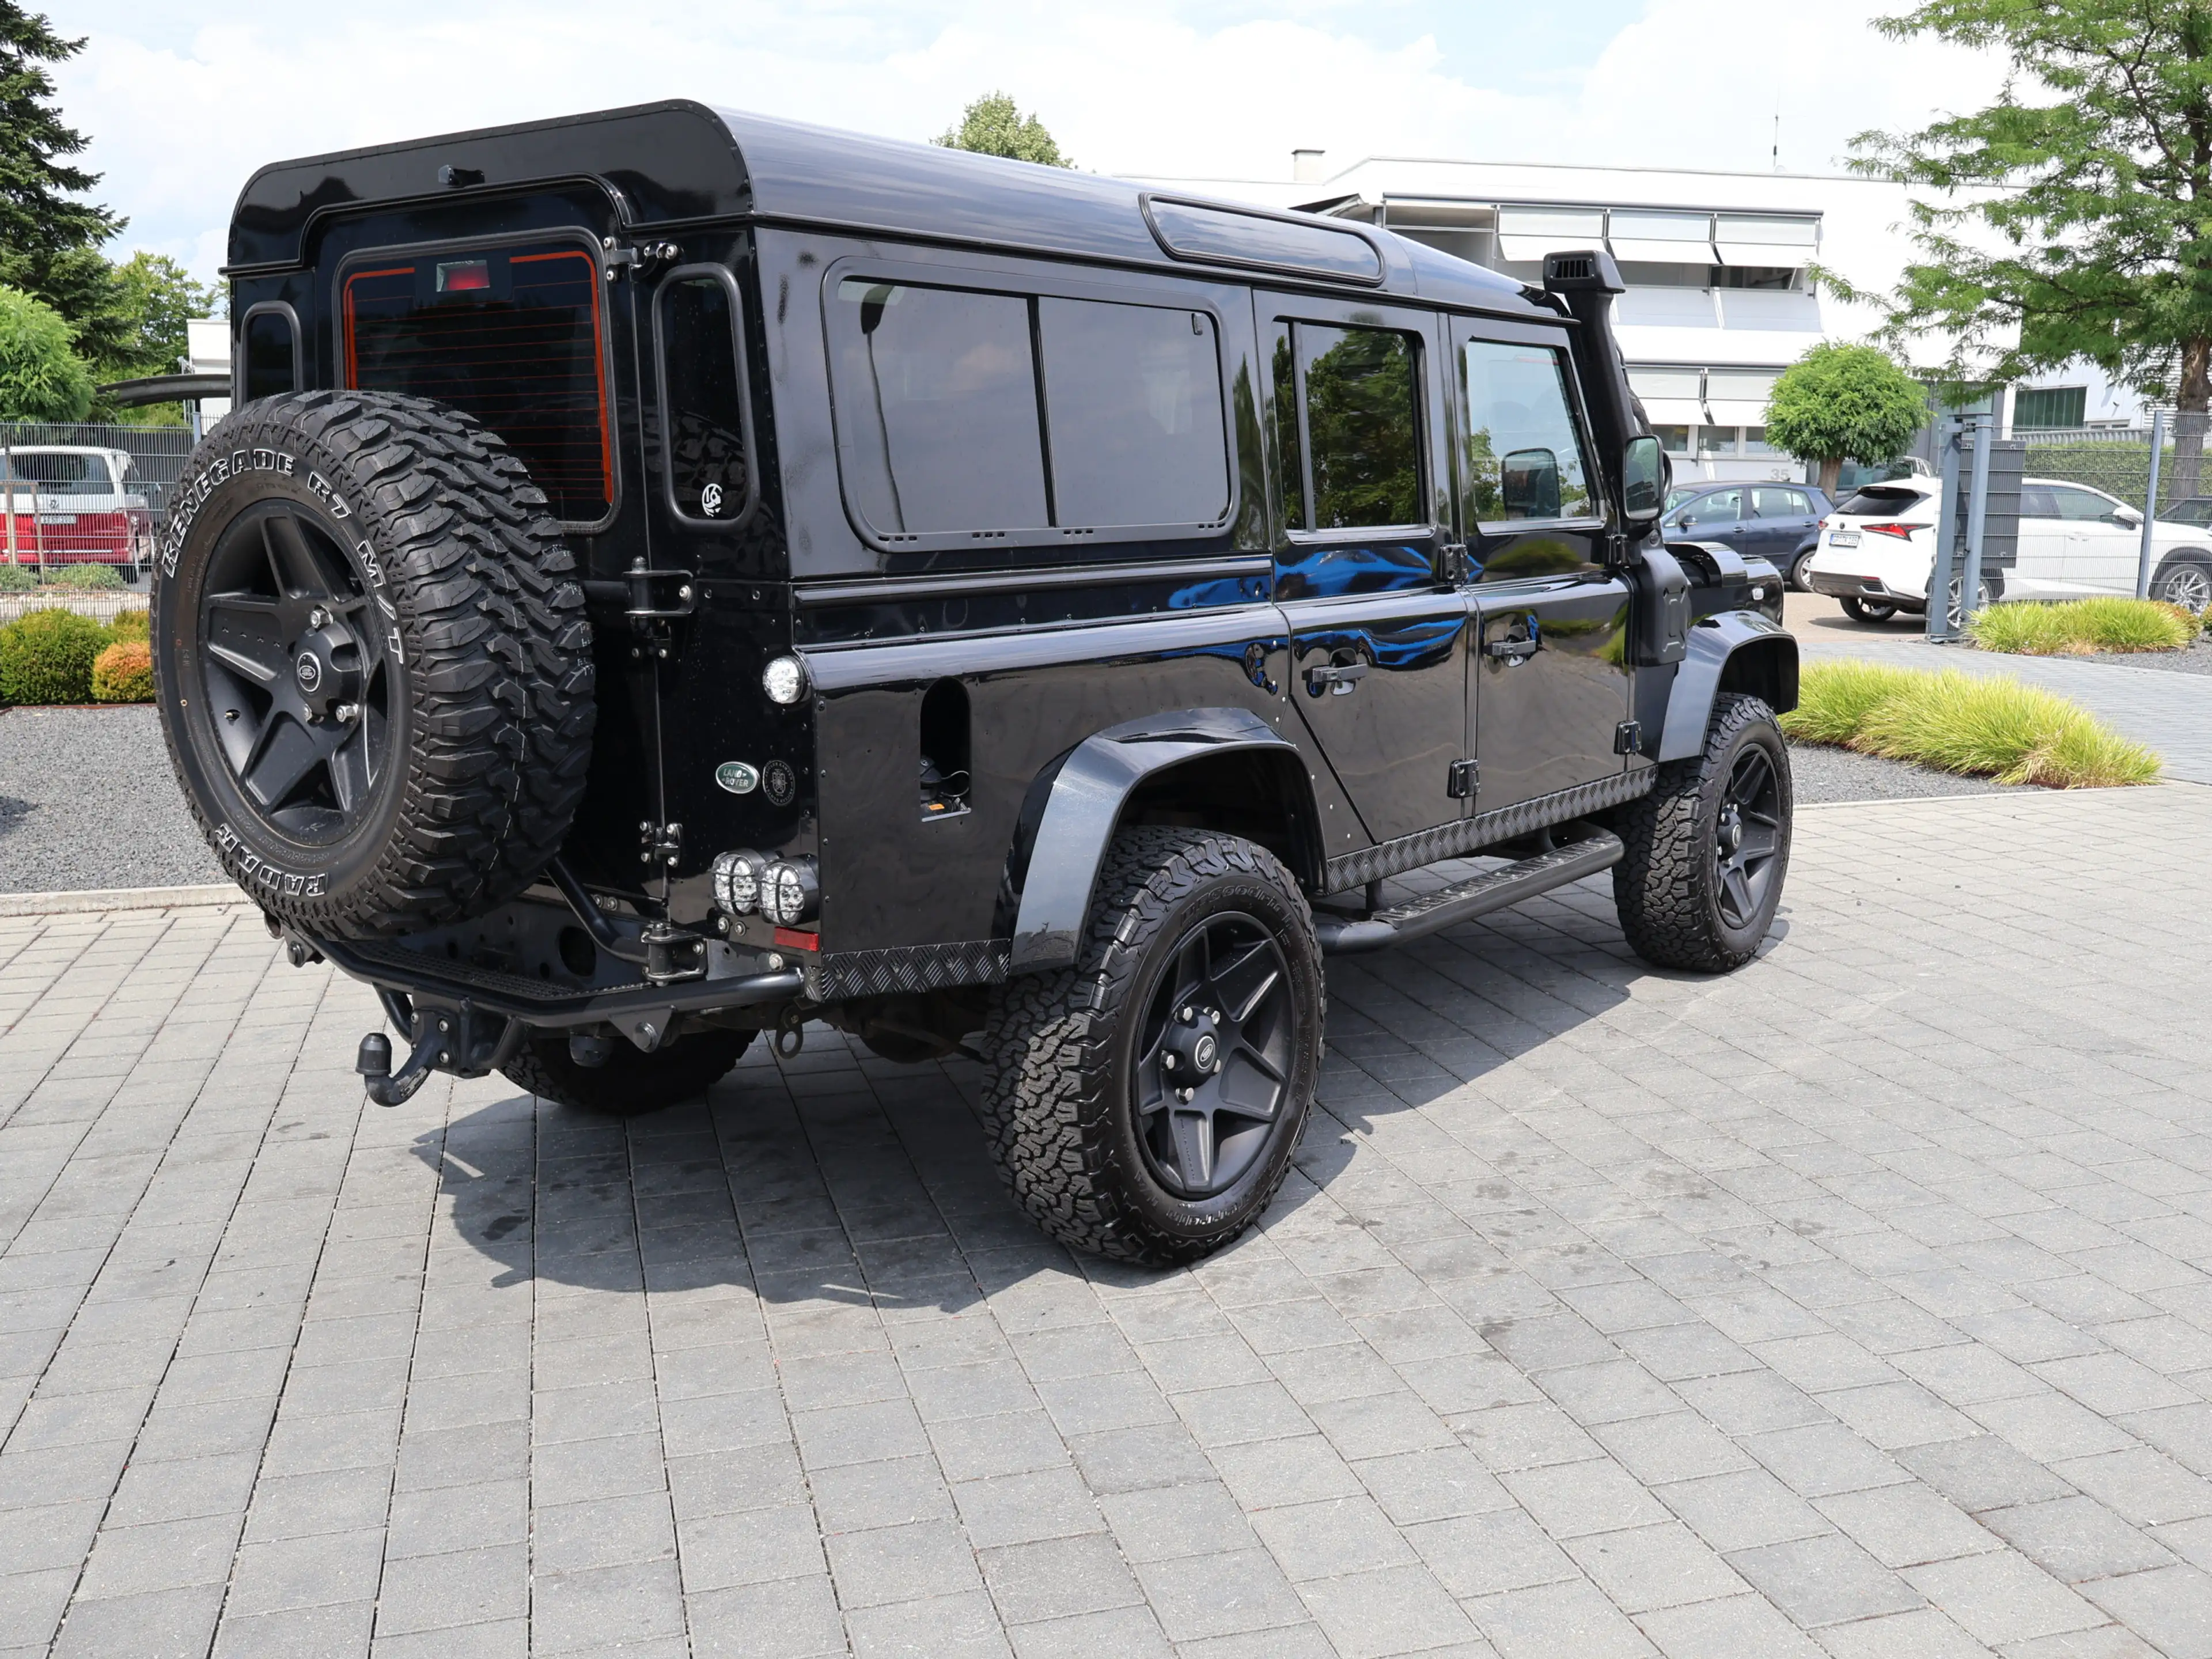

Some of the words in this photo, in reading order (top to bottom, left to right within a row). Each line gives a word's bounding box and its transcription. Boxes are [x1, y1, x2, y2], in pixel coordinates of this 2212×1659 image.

[1770, 468, 1789, 480] 35
[161, 448, 297, 579] RENEGADE
[307, 469, 352, 519] R7
[357, 539, 404, 665] M/T
[723, 768, 743, 778] LAND
[725, 777, 749, 787] ROVER
[215, 822, 328, 897] RADAR
